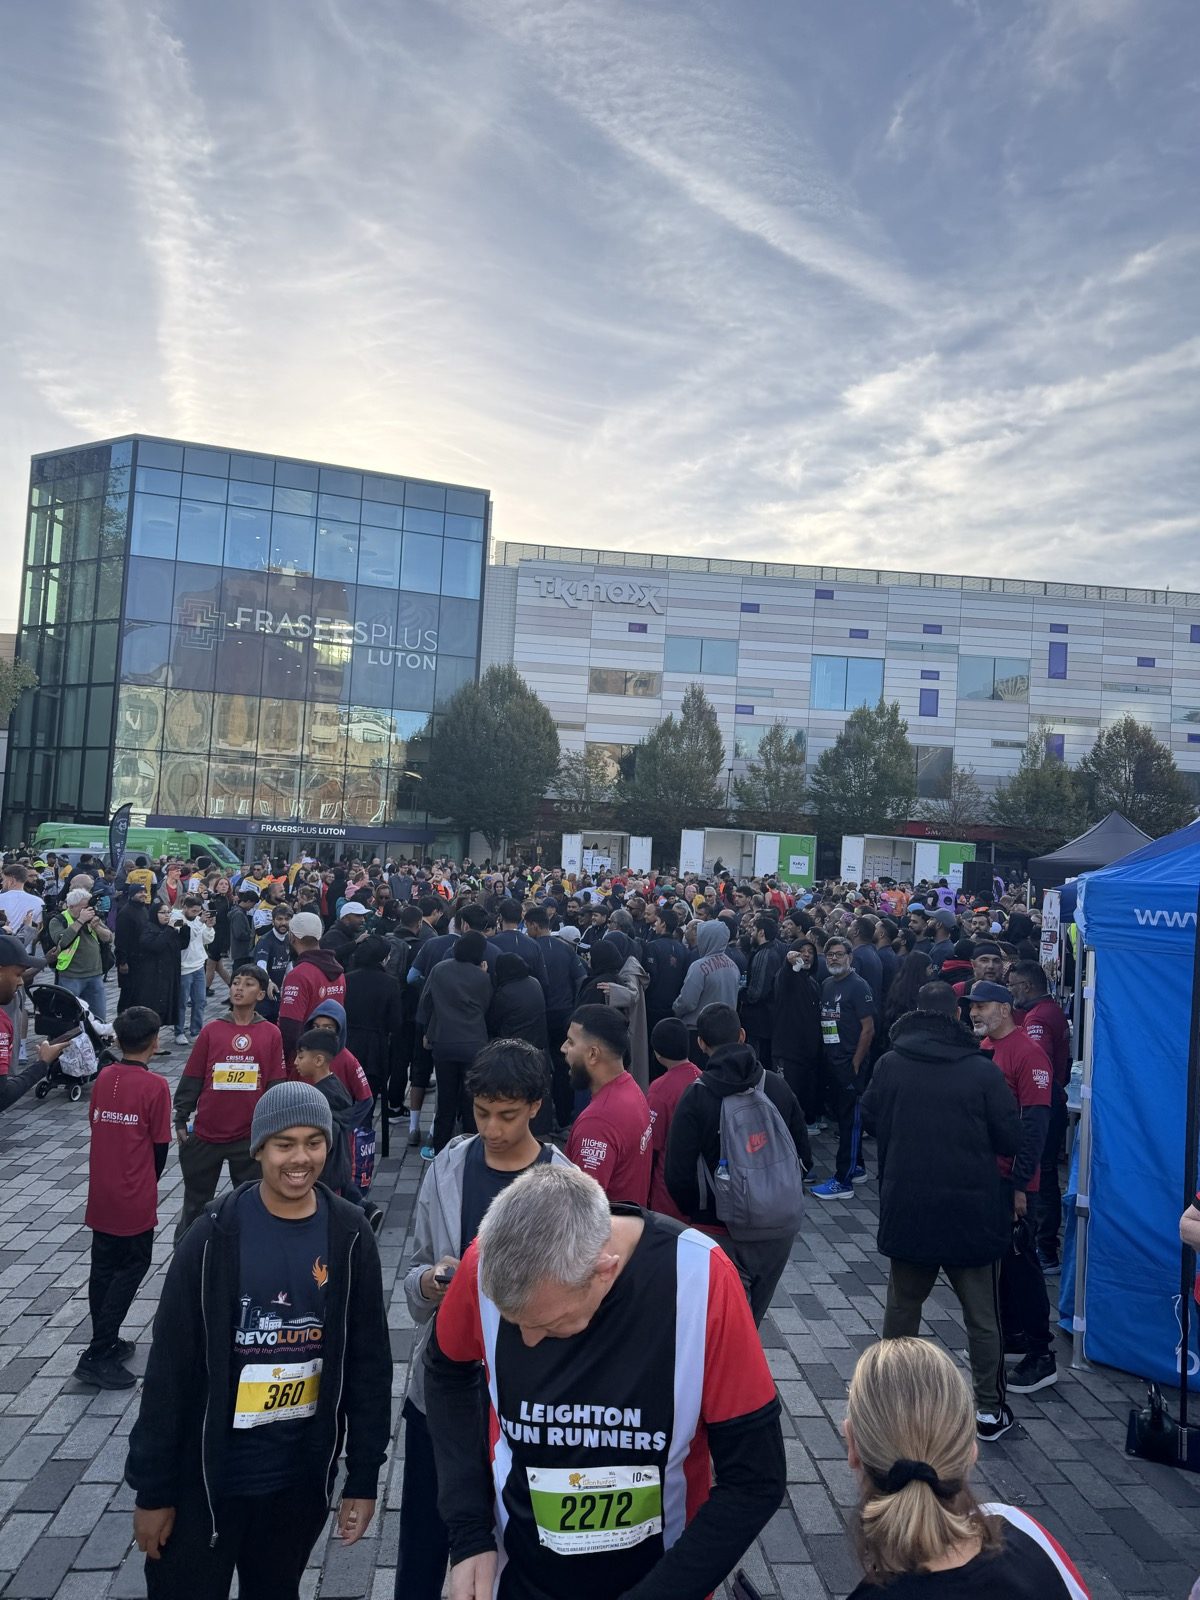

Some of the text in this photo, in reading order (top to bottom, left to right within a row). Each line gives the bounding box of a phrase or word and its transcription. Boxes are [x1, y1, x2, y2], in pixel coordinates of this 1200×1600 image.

[236, 607, 438, 652] FRASERSPLUS
[367, 649, 436, 671] LUTON
[261, 824, 346, 836] FRASERSPLUS LUTON
[1133, 908, 1198, 928] ww
[226, 1071, 246, 1083] 512
[101, 1110, 123, 1121] CRISIS
[123, 1113, 139, 1122] AID
[581, 1138, 608, 1149] HIGHER
[235, 1328, 322, 1346] REVOLUTIO
[264, 1380, 305, 1411] 360
[519, 1400, 641, 1428] LEIGHTON
[547, 1427, 667, 1451] RUNNERS
[560, 1491, 633, 1531] 2272
